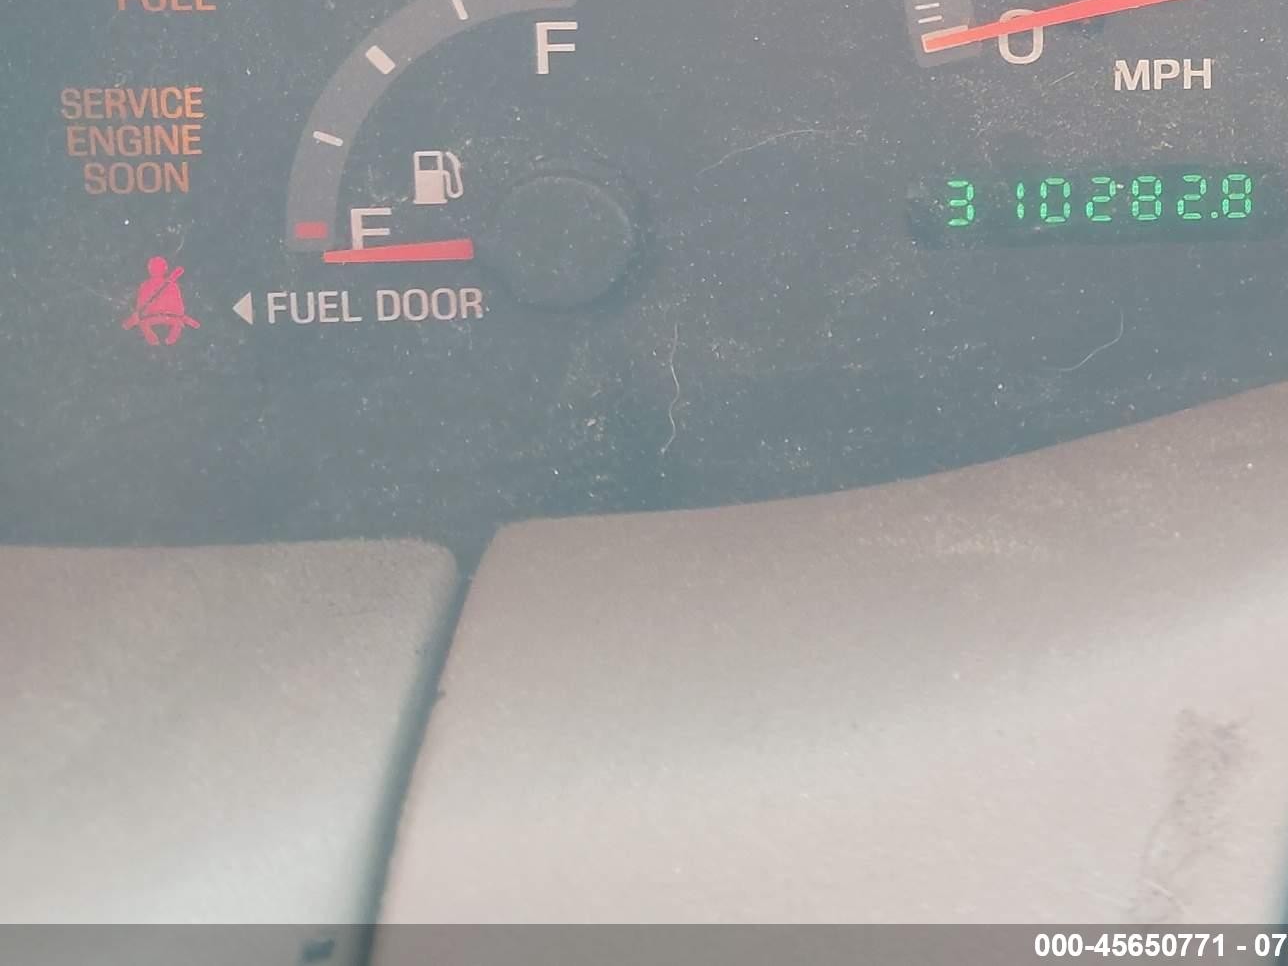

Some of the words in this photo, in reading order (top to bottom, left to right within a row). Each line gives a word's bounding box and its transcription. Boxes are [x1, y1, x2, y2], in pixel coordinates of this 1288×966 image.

[535, 21, 577, 74] F
[998, 8, 1044, 64] 0
[1113, 58, 1213, 91] MPH
[60, 87, 204, 120] SERVICE
[67, 124, 203, 157] ENGINE
[84, 163, 189, 195] SOON
[266, 291, 362, 325] FUEL
[376, 288, 484, 322] DOOR
